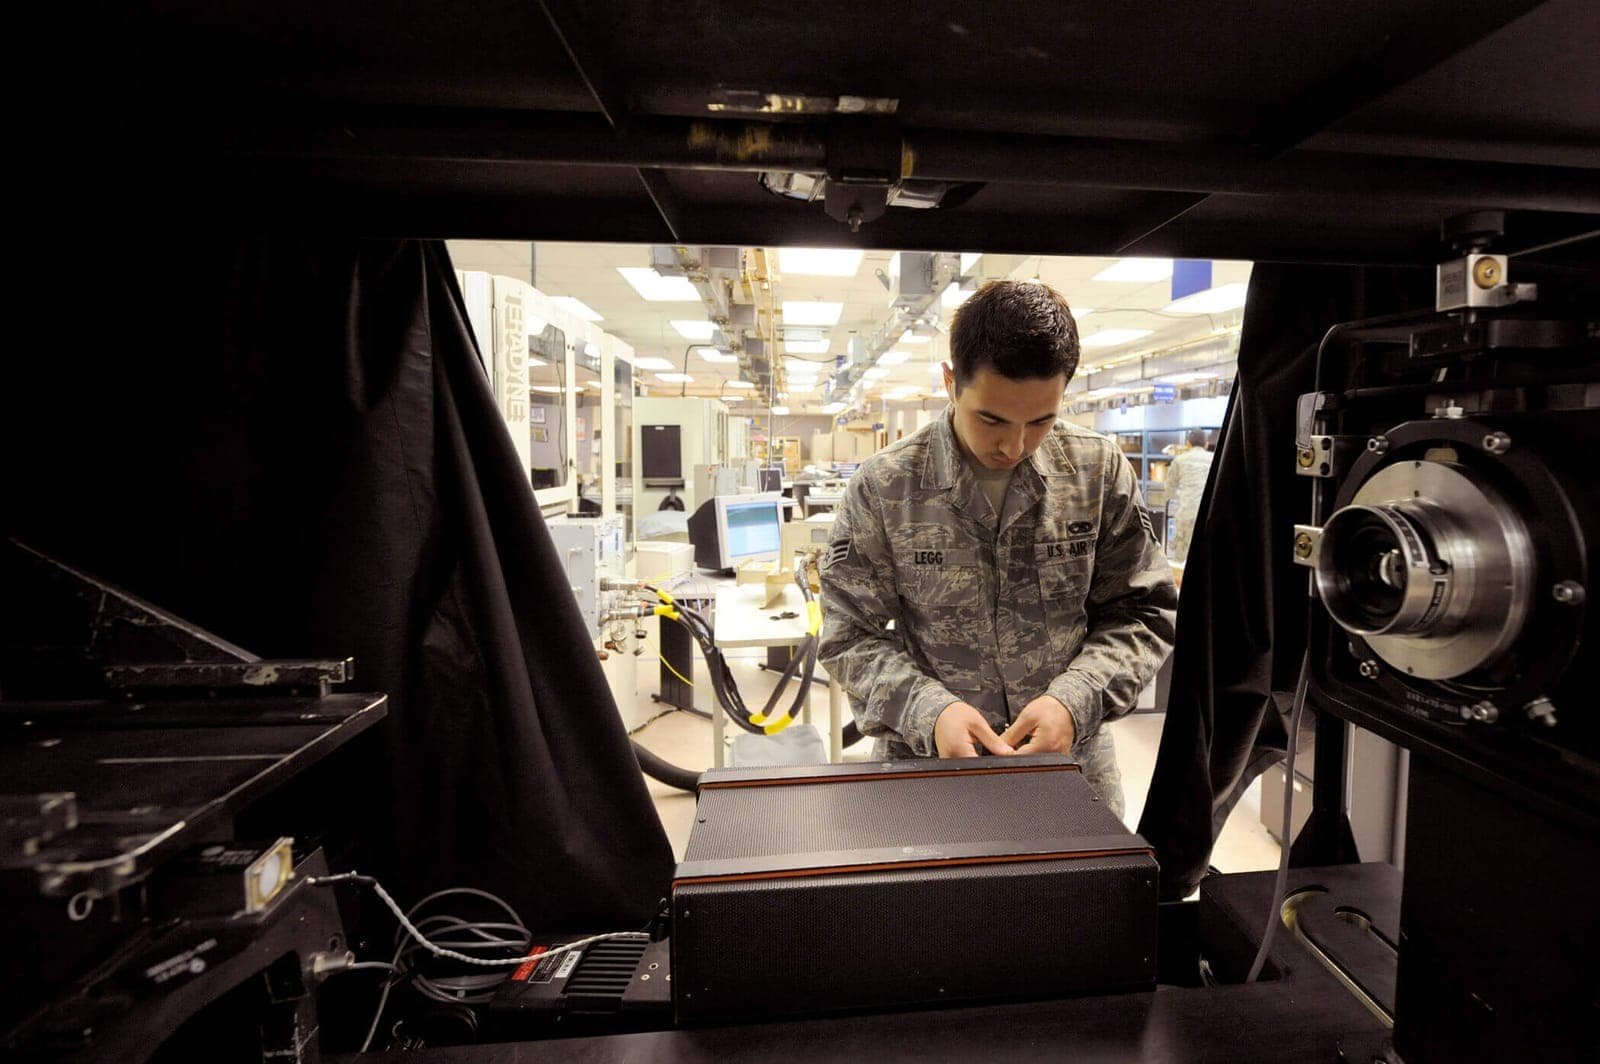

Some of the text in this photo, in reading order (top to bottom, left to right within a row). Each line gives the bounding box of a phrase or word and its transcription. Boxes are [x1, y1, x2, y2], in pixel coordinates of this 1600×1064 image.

[504, 289, 525, 423] TERADYNE
[1069, 541, 1087, 556] AIR
[914, 551, 943, 565] LEGG
